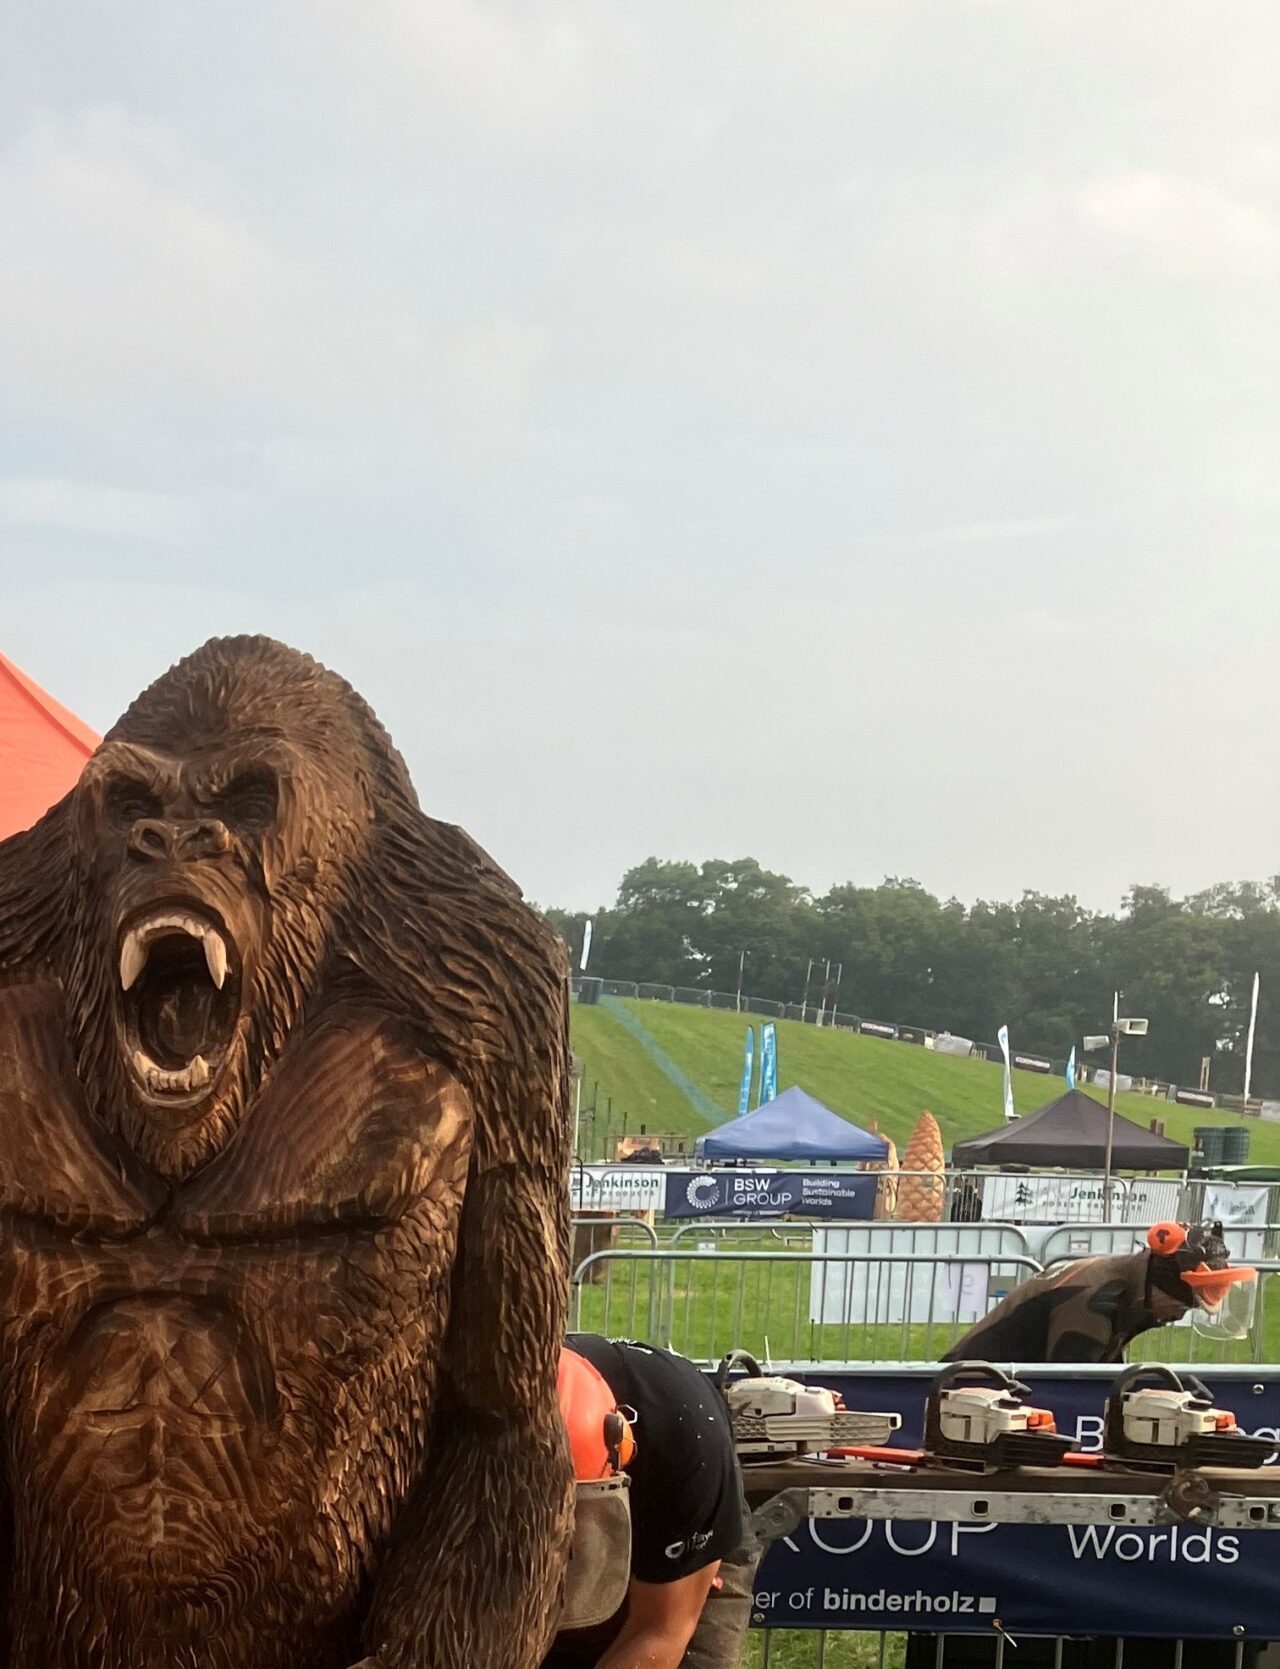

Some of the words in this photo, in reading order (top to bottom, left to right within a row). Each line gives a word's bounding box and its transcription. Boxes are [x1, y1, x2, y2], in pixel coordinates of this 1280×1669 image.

[734, 1178, 771, 1191] BSW
[802, 1178, 840, 1189] Building
[733, 1192, 792, 1206] GROUP
[802, 1187, 856, 1198] Sustainable
[1067, 1525, 1241, 1564] Worlds
[789, 1587, 816, 1610] of
[823, 1587, 976, 1613] binderholz
